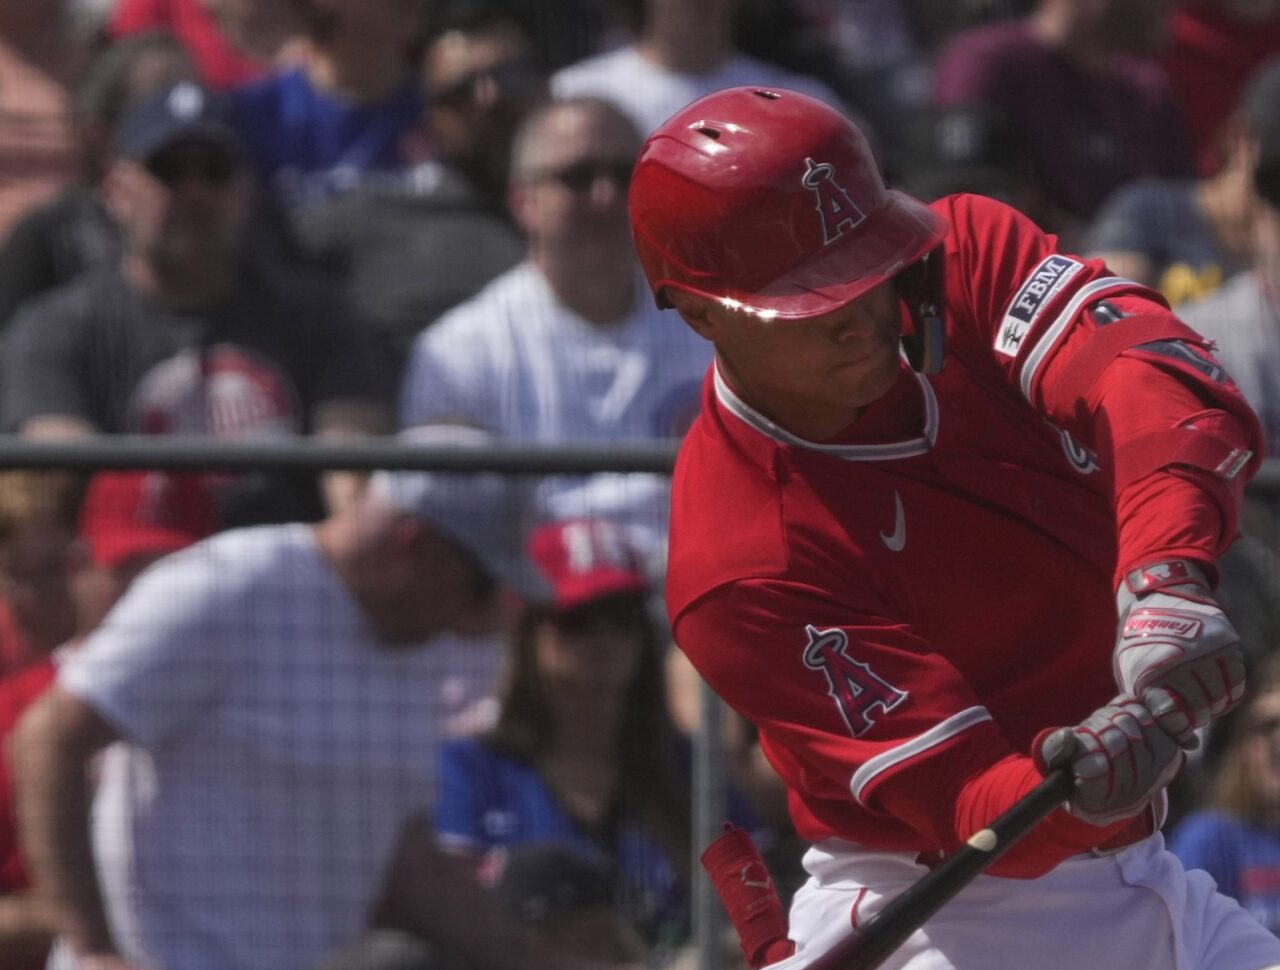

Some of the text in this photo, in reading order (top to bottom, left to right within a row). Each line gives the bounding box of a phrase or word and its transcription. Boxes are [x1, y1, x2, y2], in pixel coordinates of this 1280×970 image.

[802, 157, 867, 245] A
[1014, 259, 1067, 315] FBM
[803, 624, 908, 738] A
